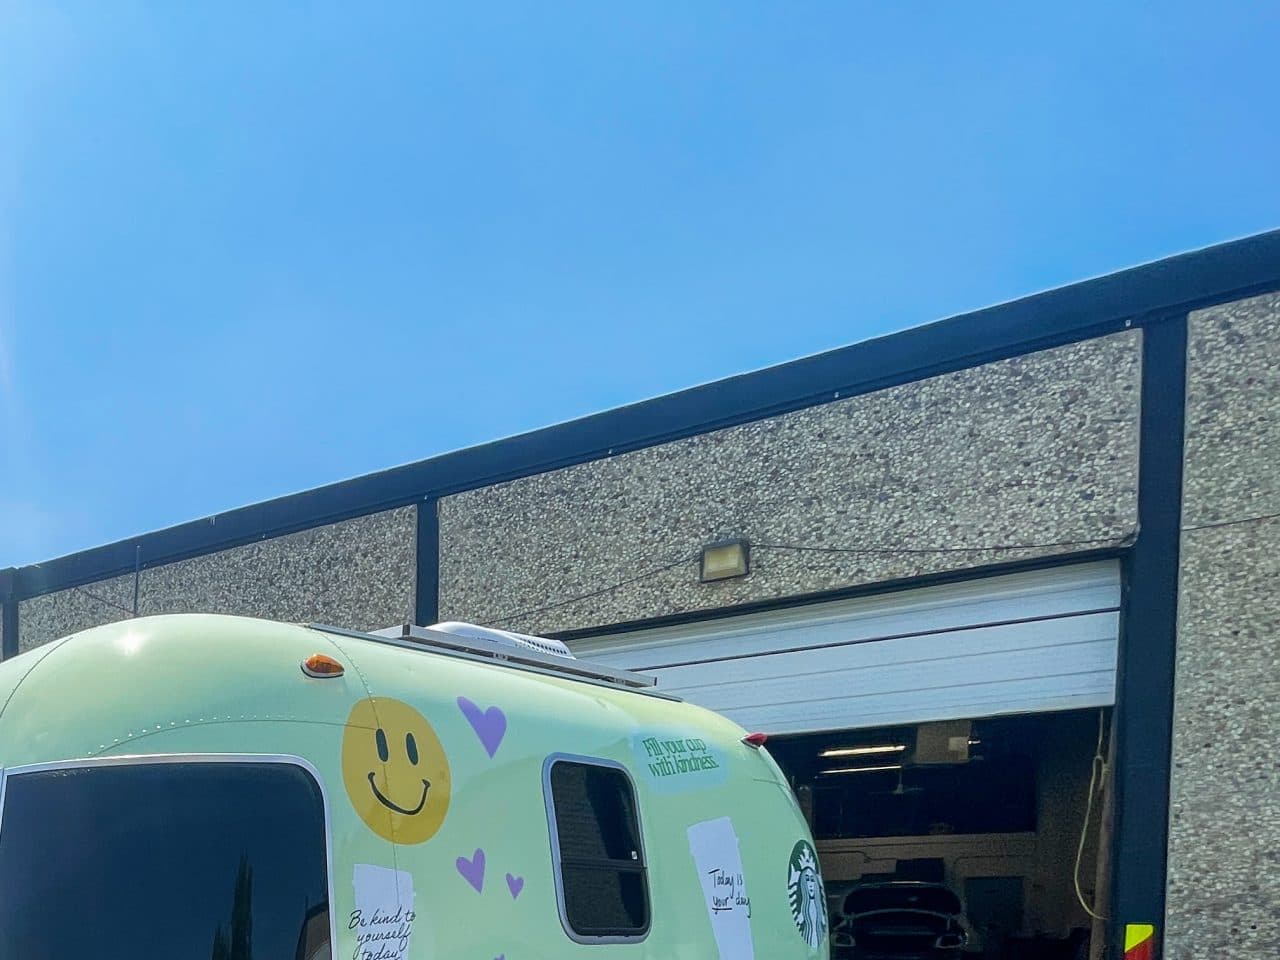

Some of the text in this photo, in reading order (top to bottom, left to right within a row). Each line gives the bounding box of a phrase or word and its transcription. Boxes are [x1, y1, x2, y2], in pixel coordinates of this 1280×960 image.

[642, 737, 707, 758] Fill your cup
[648, 755, 676, 776] with
[708, 868, 743, 899] Today is
[348, 904, 416, 929] Be kind to
[712, 890, 752, 918] your day
[352, 922, 411, 960] yourself
